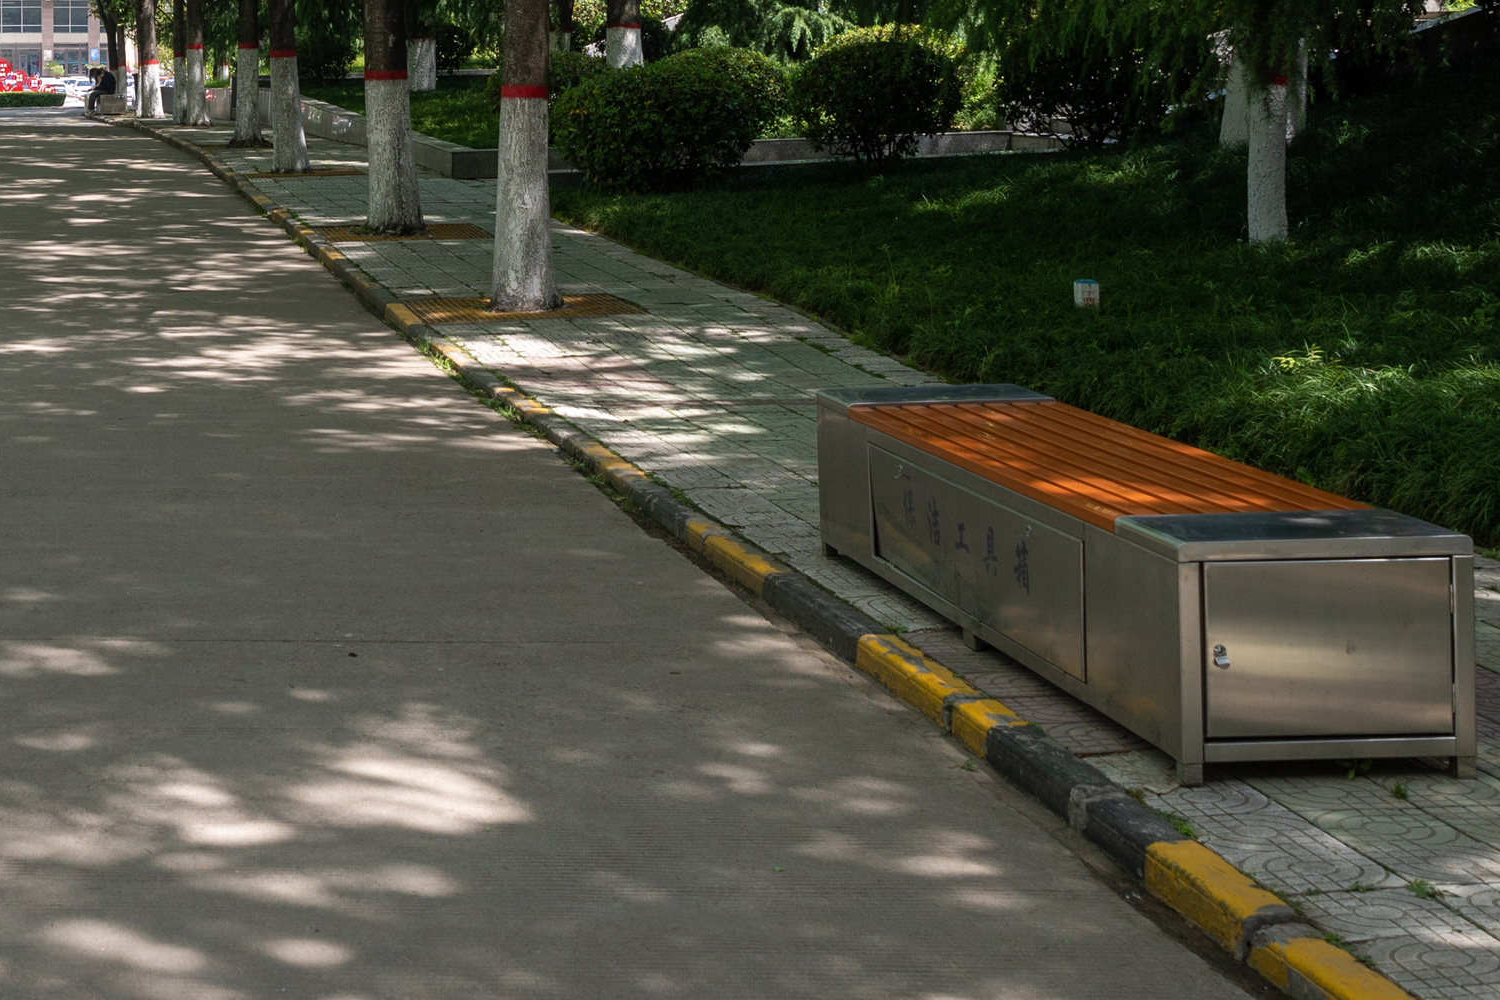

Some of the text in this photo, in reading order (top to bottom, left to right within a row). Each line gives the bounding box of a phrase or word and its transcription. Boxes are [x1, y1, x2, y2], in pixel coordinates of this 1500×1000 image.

[902, 488, 1031, 596] 保洁工具箱
